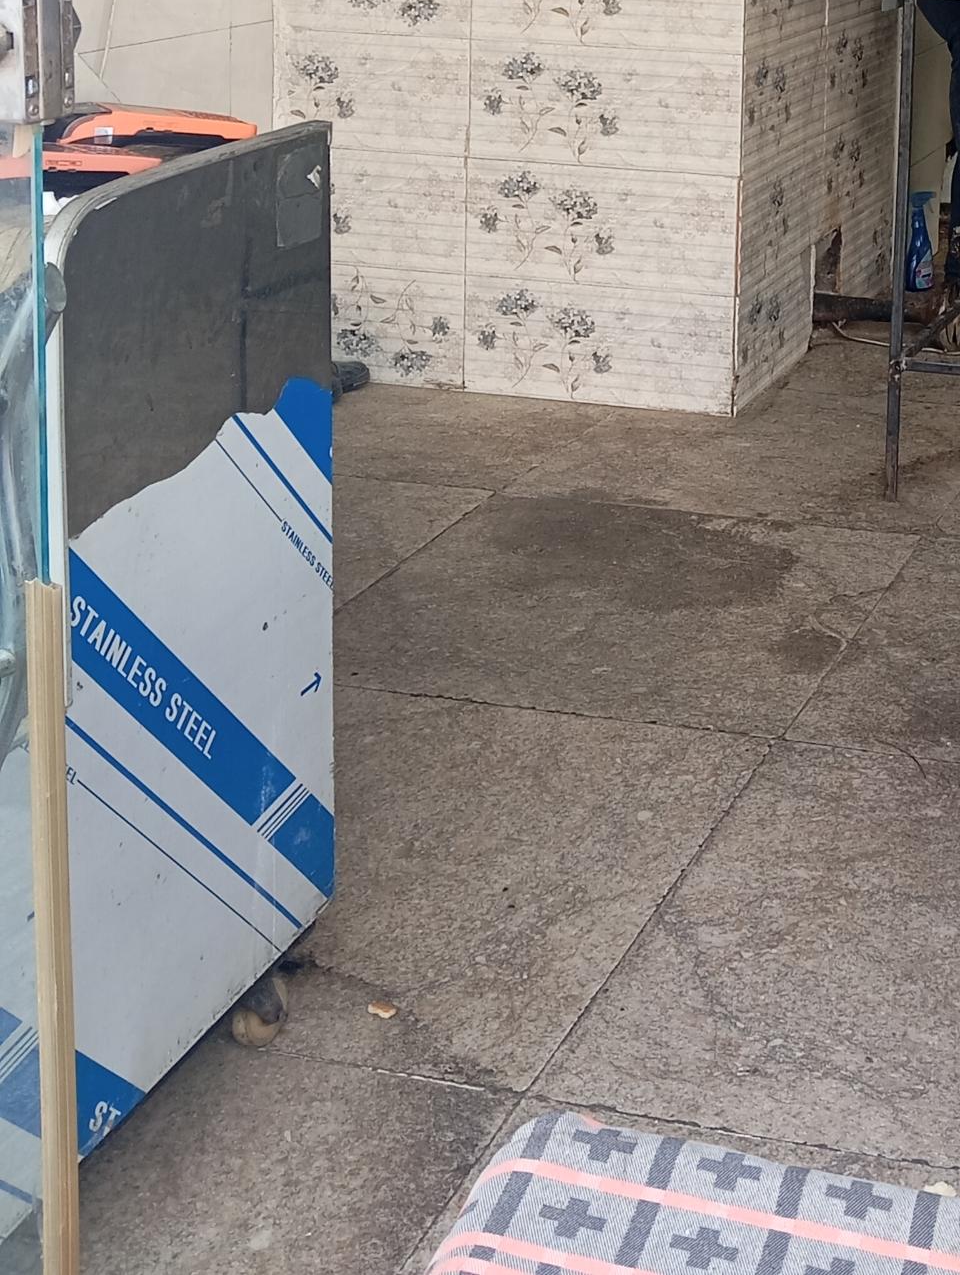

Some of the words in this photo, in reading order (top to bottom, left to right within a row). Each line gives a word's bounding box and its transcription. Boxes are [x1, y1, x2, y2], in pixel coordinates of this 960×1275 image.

[281, 520, 316, 567] STAINLESS
[71, 595, 167, 707] STAINLESS
[165, 692, 217, 760] STEEL
